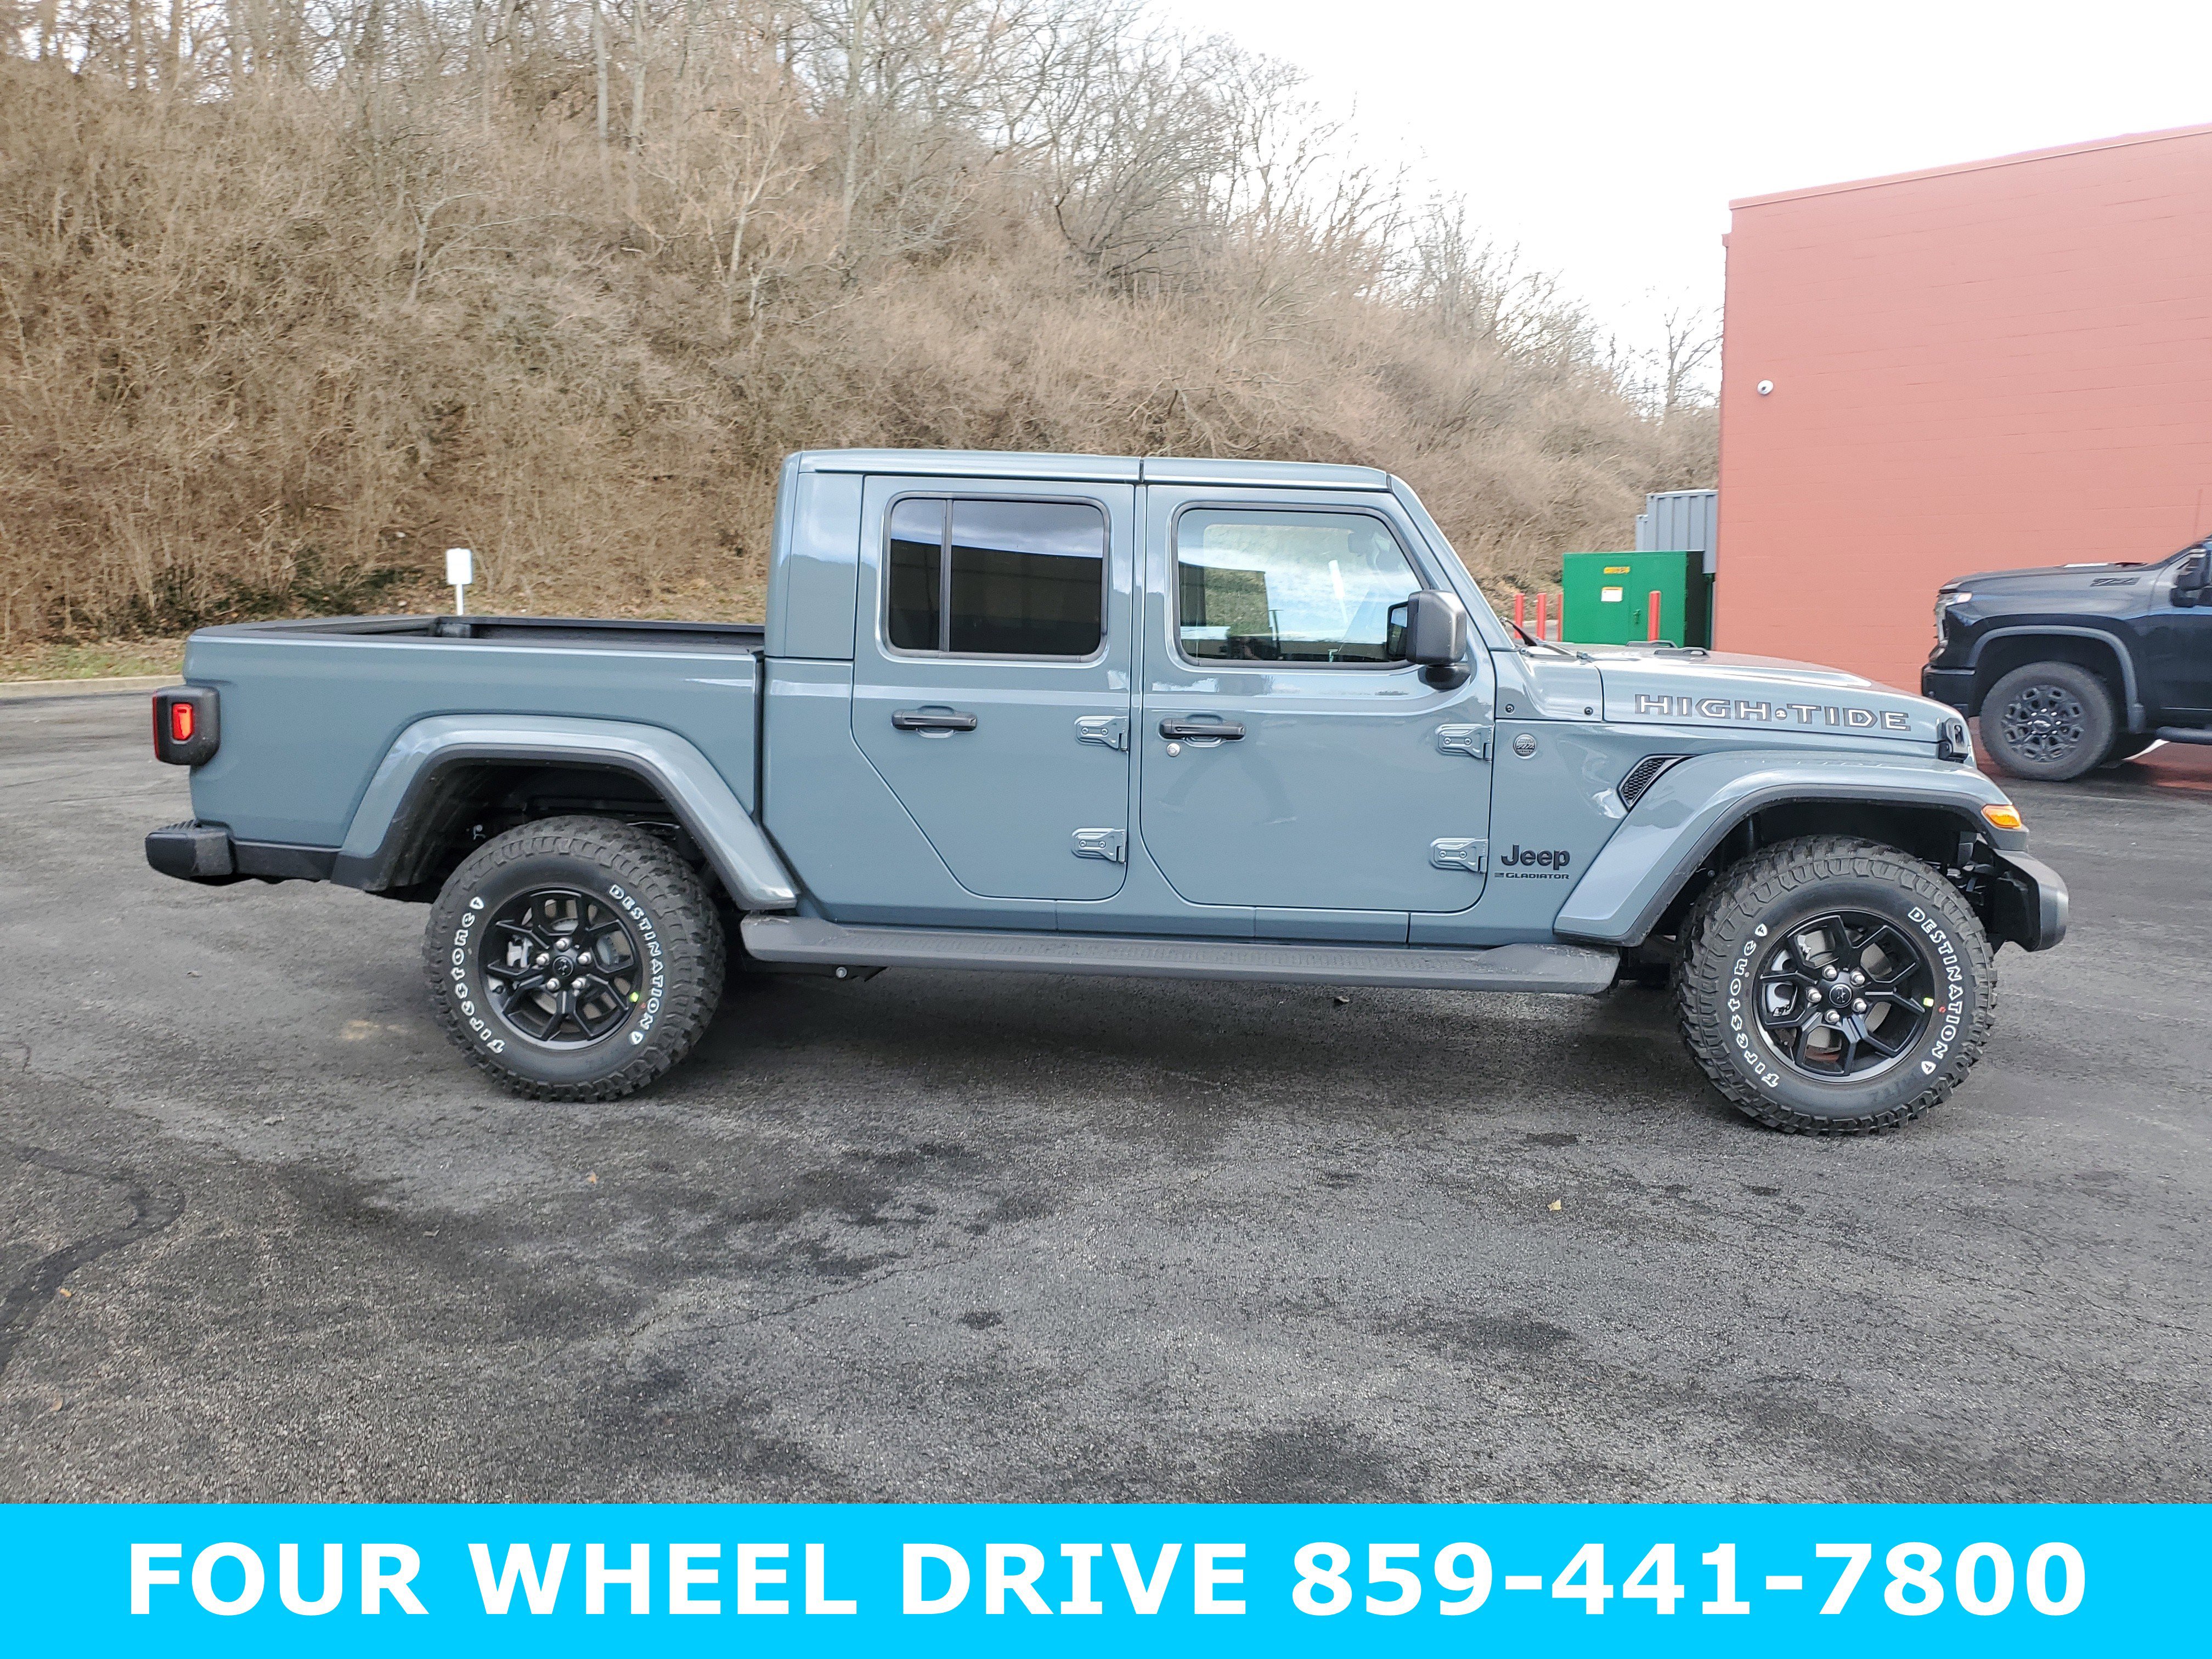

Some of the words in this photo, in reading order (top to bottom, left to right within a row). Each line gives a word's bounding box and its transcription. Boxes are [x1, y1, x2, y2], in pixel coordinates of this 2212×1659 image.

[1634, 693, 1773, 722] HIGH
[1786, 703, 1911, 731] TIDE
[1500, 844, 1570, 871] Jeep
[609, 884, 664, 1030] DESTINATION
[1907, 907, 1963, 1060] DESTINATION
